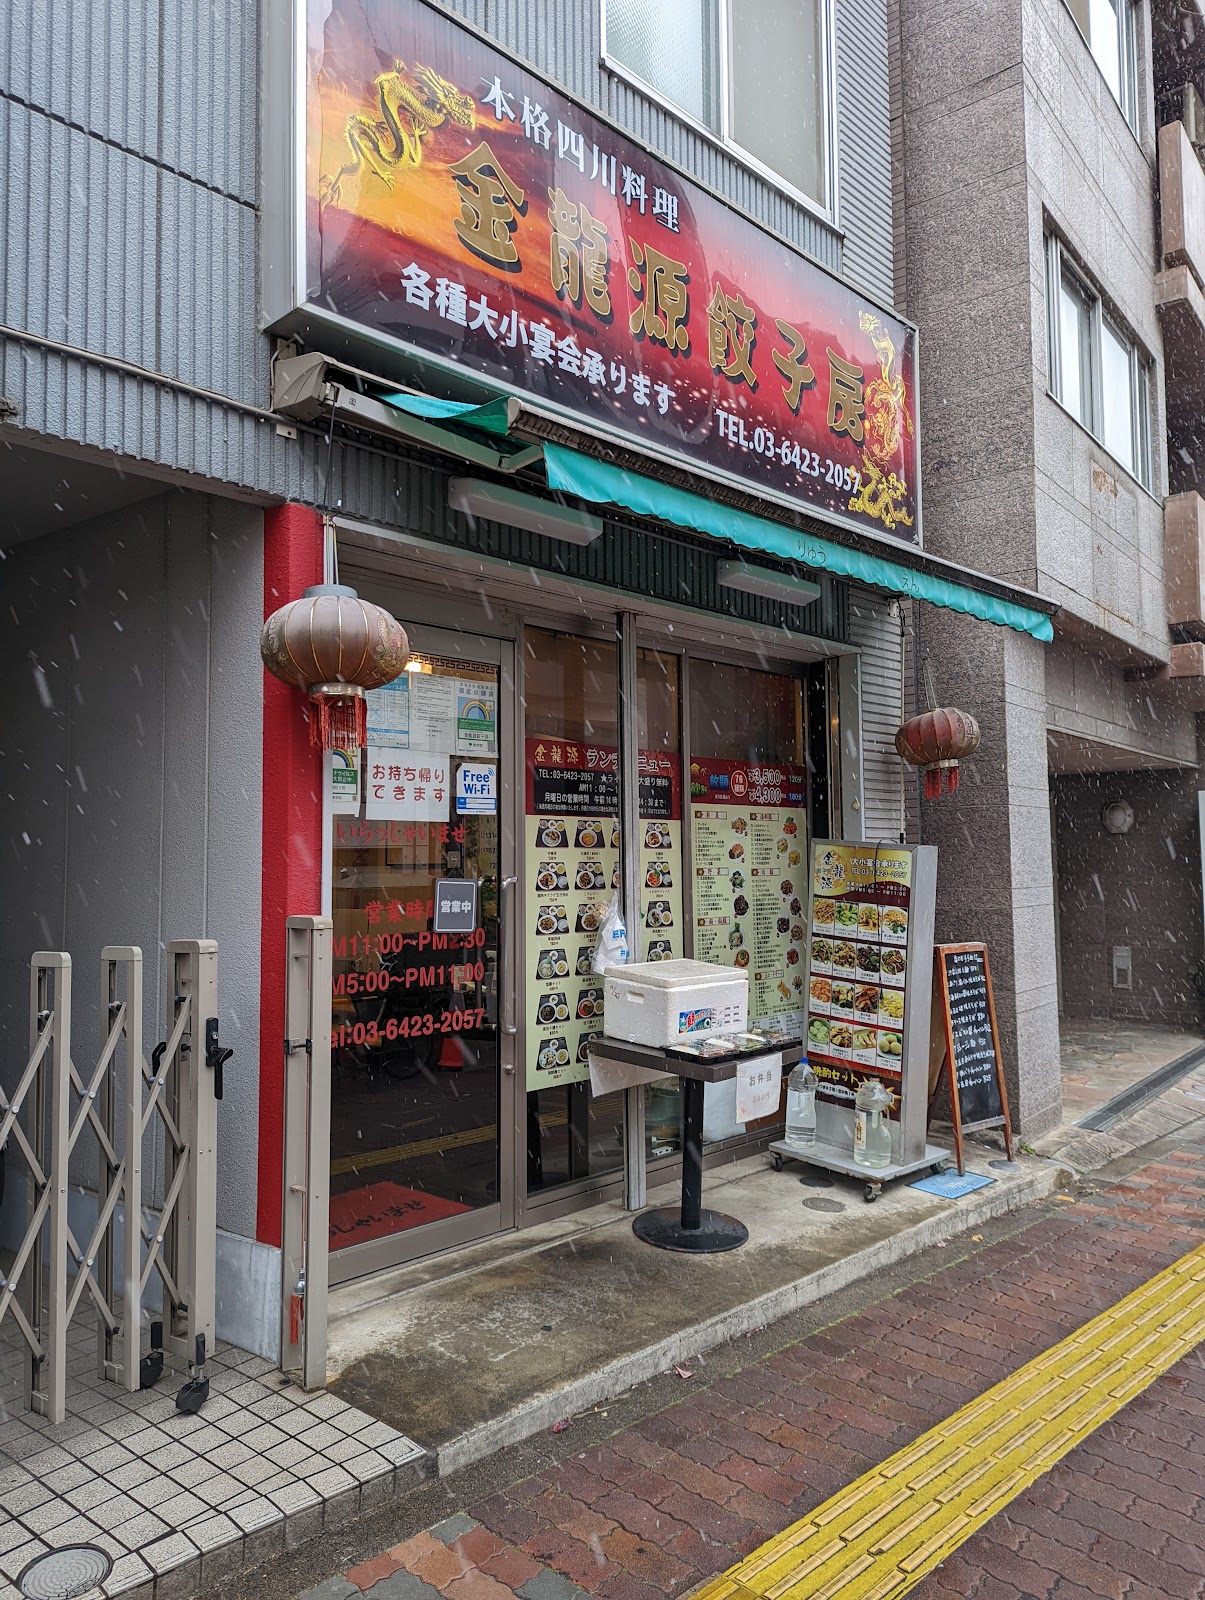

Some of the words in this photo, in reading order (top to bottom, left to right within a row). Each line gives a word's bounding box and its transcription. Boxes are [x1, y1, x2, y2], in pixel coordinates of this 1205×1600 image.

[480, 76, 680, 233] 本格四川料理
[449, 141, 866, 444] 金龍源餃子房
[400, 261, 677, 415] 各種大小宴会承ります
[715, 408, 861, 495] TEL.03-6423-2057
[797, 539, 826, 564] りゅう
[902, 572, 920, 594] えん
[372, 764, 445, 784] お持ち帰り
[463, 769, 490, 783] Free
[538, 769, 595, 782] TEL:03-6423-2057
[735, 774, 743, 784] 76
[372, 784, 446, 803] できます
[463, 783, 490, 795] Wi-Fi
[337, 820, 468, 844] いらっしゃいませ
[440, 900, 472, 914] 営業中
[749, 1070, 772, 1087] お弁当
[813, 1065, 859, 1084] 晩酌セット
